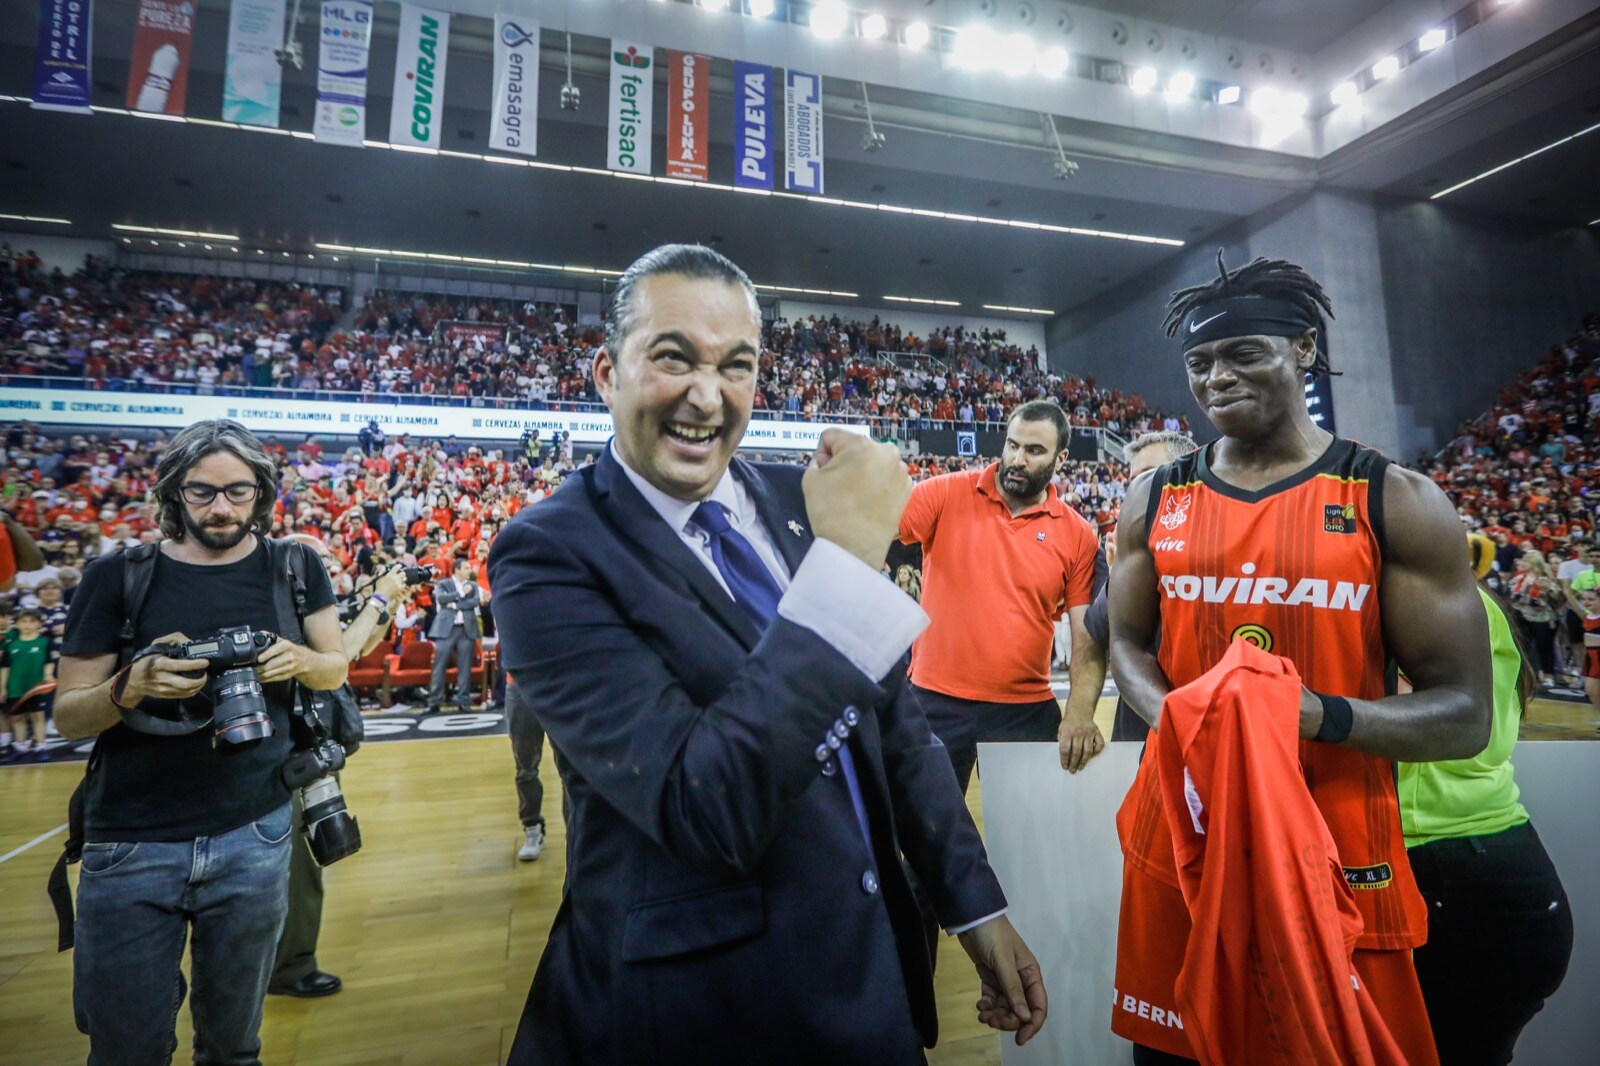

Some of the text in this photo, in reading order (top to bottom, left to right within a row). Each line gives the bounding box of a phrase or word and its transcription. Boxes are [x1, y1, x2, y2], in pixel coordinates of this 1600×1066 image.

[67, 0, 81, 60] OTRIL
[502, 53, 523, 148] emasagra
[681, 55, 695, 161] GRUPO LUNA
[618, 74, 642, 168] fertisac
[742, 73, 767, 181] PULEVA
[787, 105, 795, 129] MIGUEL
[797, 103, 811, 158] ABOGADOS
[242, 409, 332, 421] CERVEZAS ALHAMBRA
[395, 416, 438, 426] ALHAMBRA
[485, 419, 563, 430] CERVEZAS ALHAMBRA
[1326, 508, 1341, 516] Liga
[1325, 524, 1345, 532] ORO
[1366, 871, 1377, 881] XL
